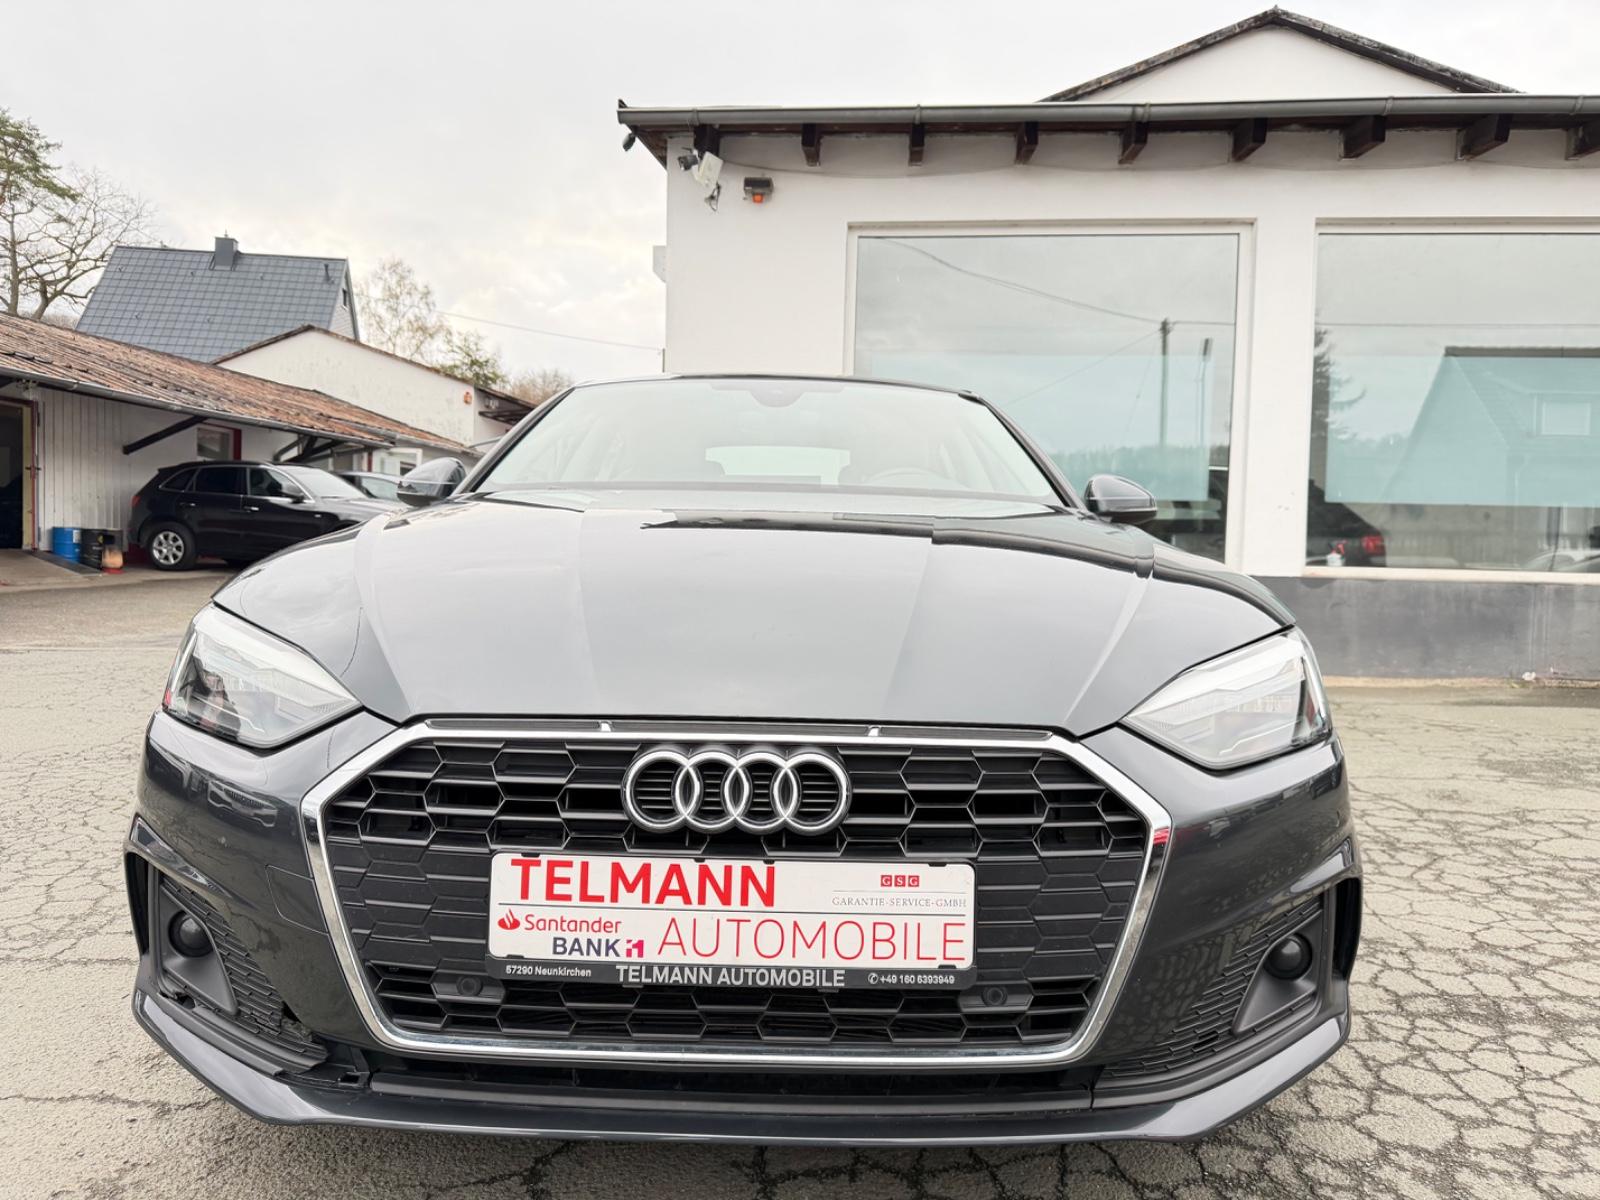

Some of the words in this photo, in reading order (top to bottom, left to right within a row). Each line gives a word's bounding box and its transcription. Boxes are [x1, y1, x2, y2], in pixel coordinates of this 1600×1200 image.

[511, 858, 775, 907] TELMANN
[881, 875, 920, 887] GSG
[524, 914, 622, 934] Santander
[657, 917, 966, 961] AUTOMOBILE
[534, 966, 592, 977] Neunkirchen
[616, 965, 713, 985] TELMANN
[717, 967, 845, 987] AUTOMOBILE
[879, 974, 898, 984] +49
